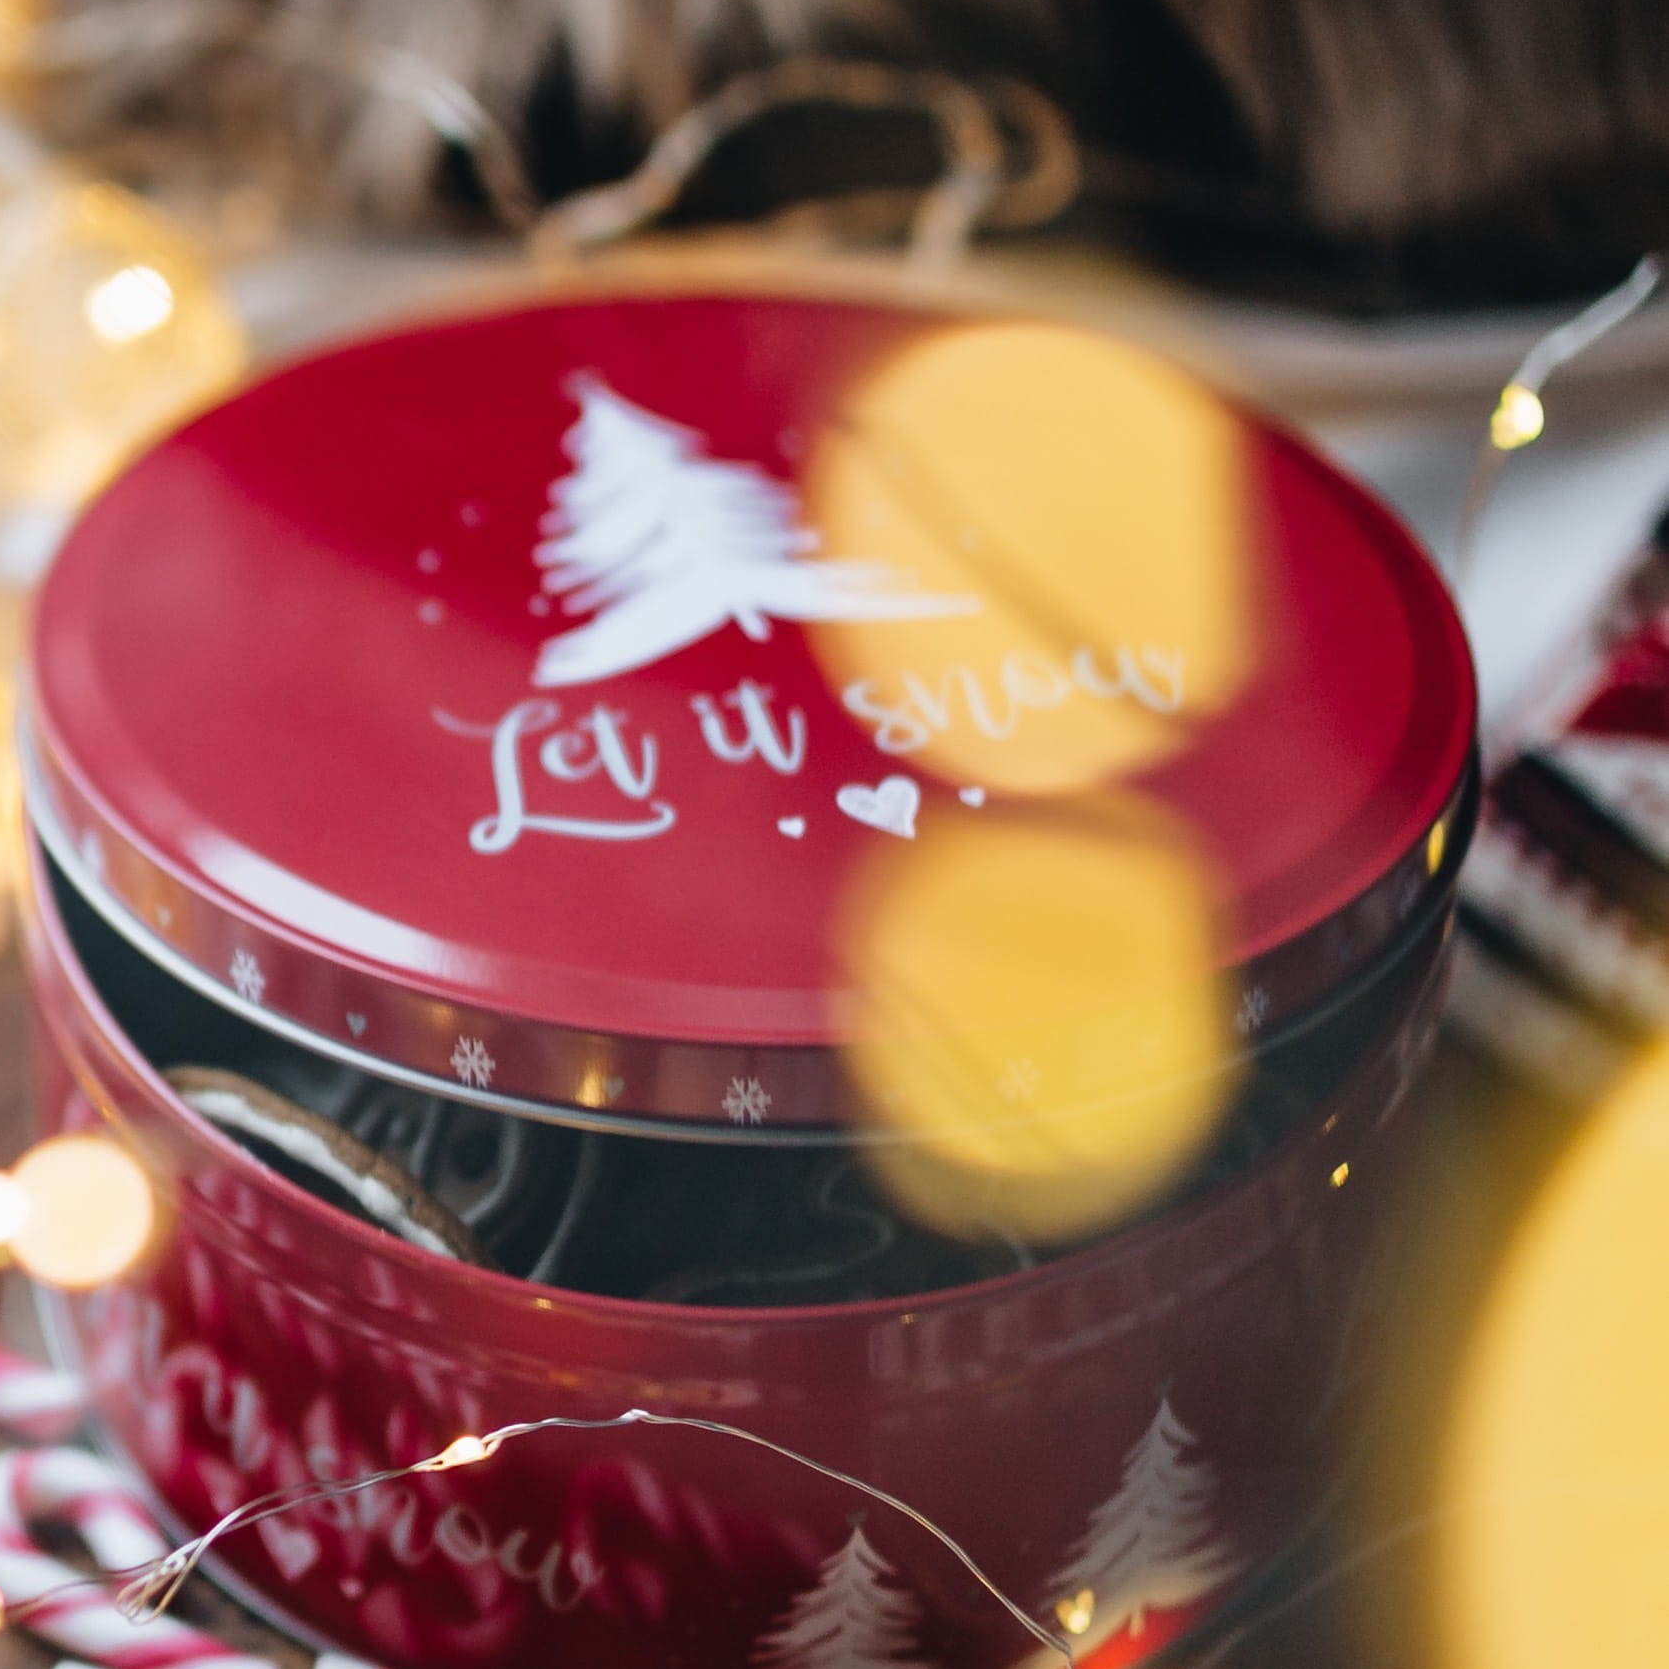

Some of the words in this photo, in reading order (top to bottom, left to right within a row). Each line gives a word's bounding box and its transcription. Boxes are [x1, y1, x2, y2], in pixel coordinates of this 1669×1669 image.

[432, 698, 677, 856] Let
[690, 678, 805, 776] it
[842, 643, 1186, 756] snow
